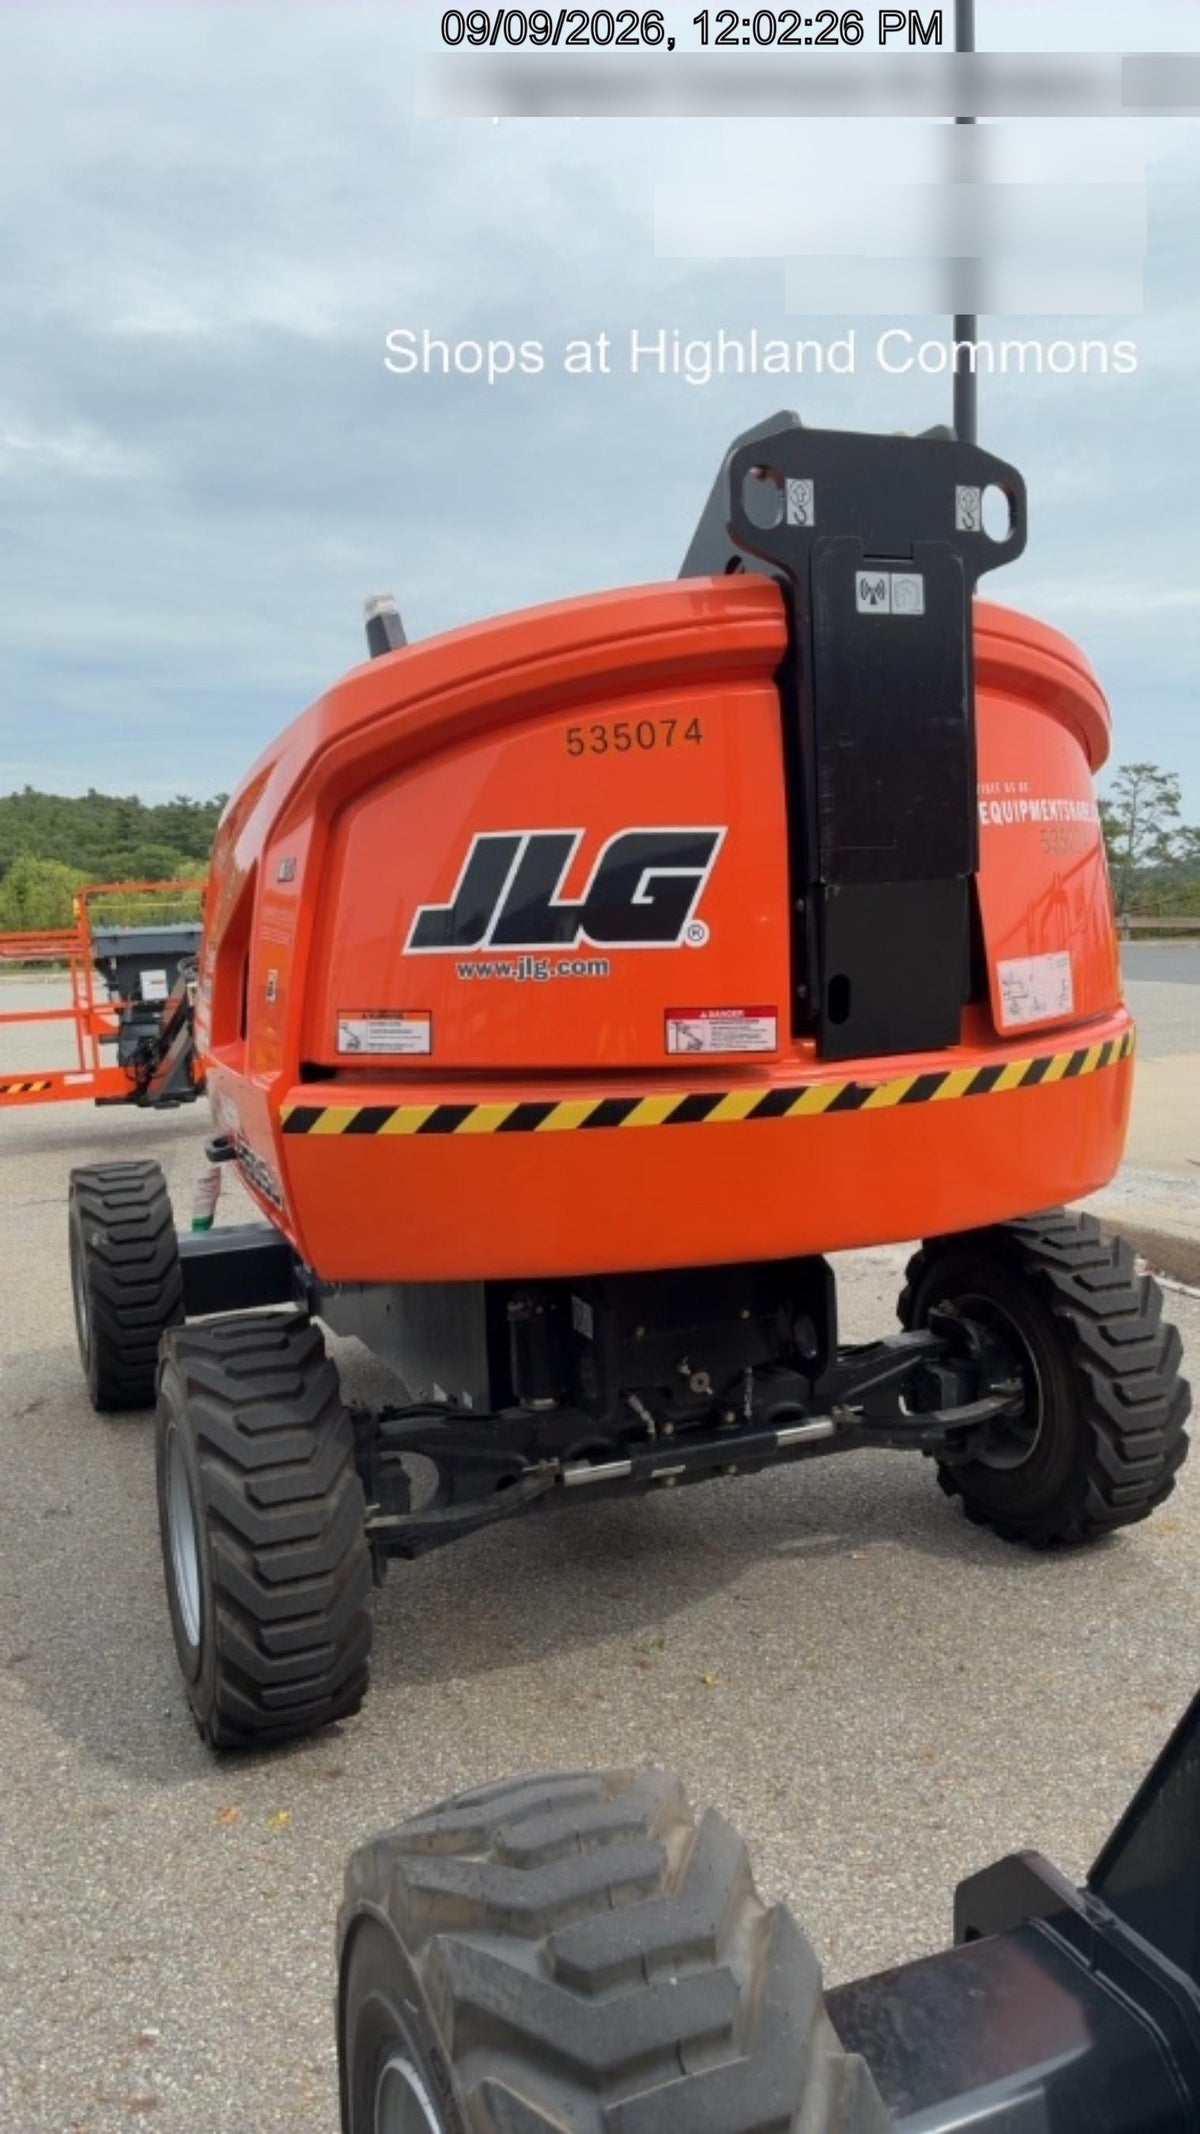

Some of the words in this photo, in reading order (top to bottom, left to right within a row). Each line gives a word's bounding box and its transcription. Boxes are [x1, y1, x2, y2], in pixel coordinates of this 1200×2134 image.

[566, 718, 702, 757] 535074
[402, 826, 727, 955] JLG
[456, 956, 610, 979] www.jlg.com
